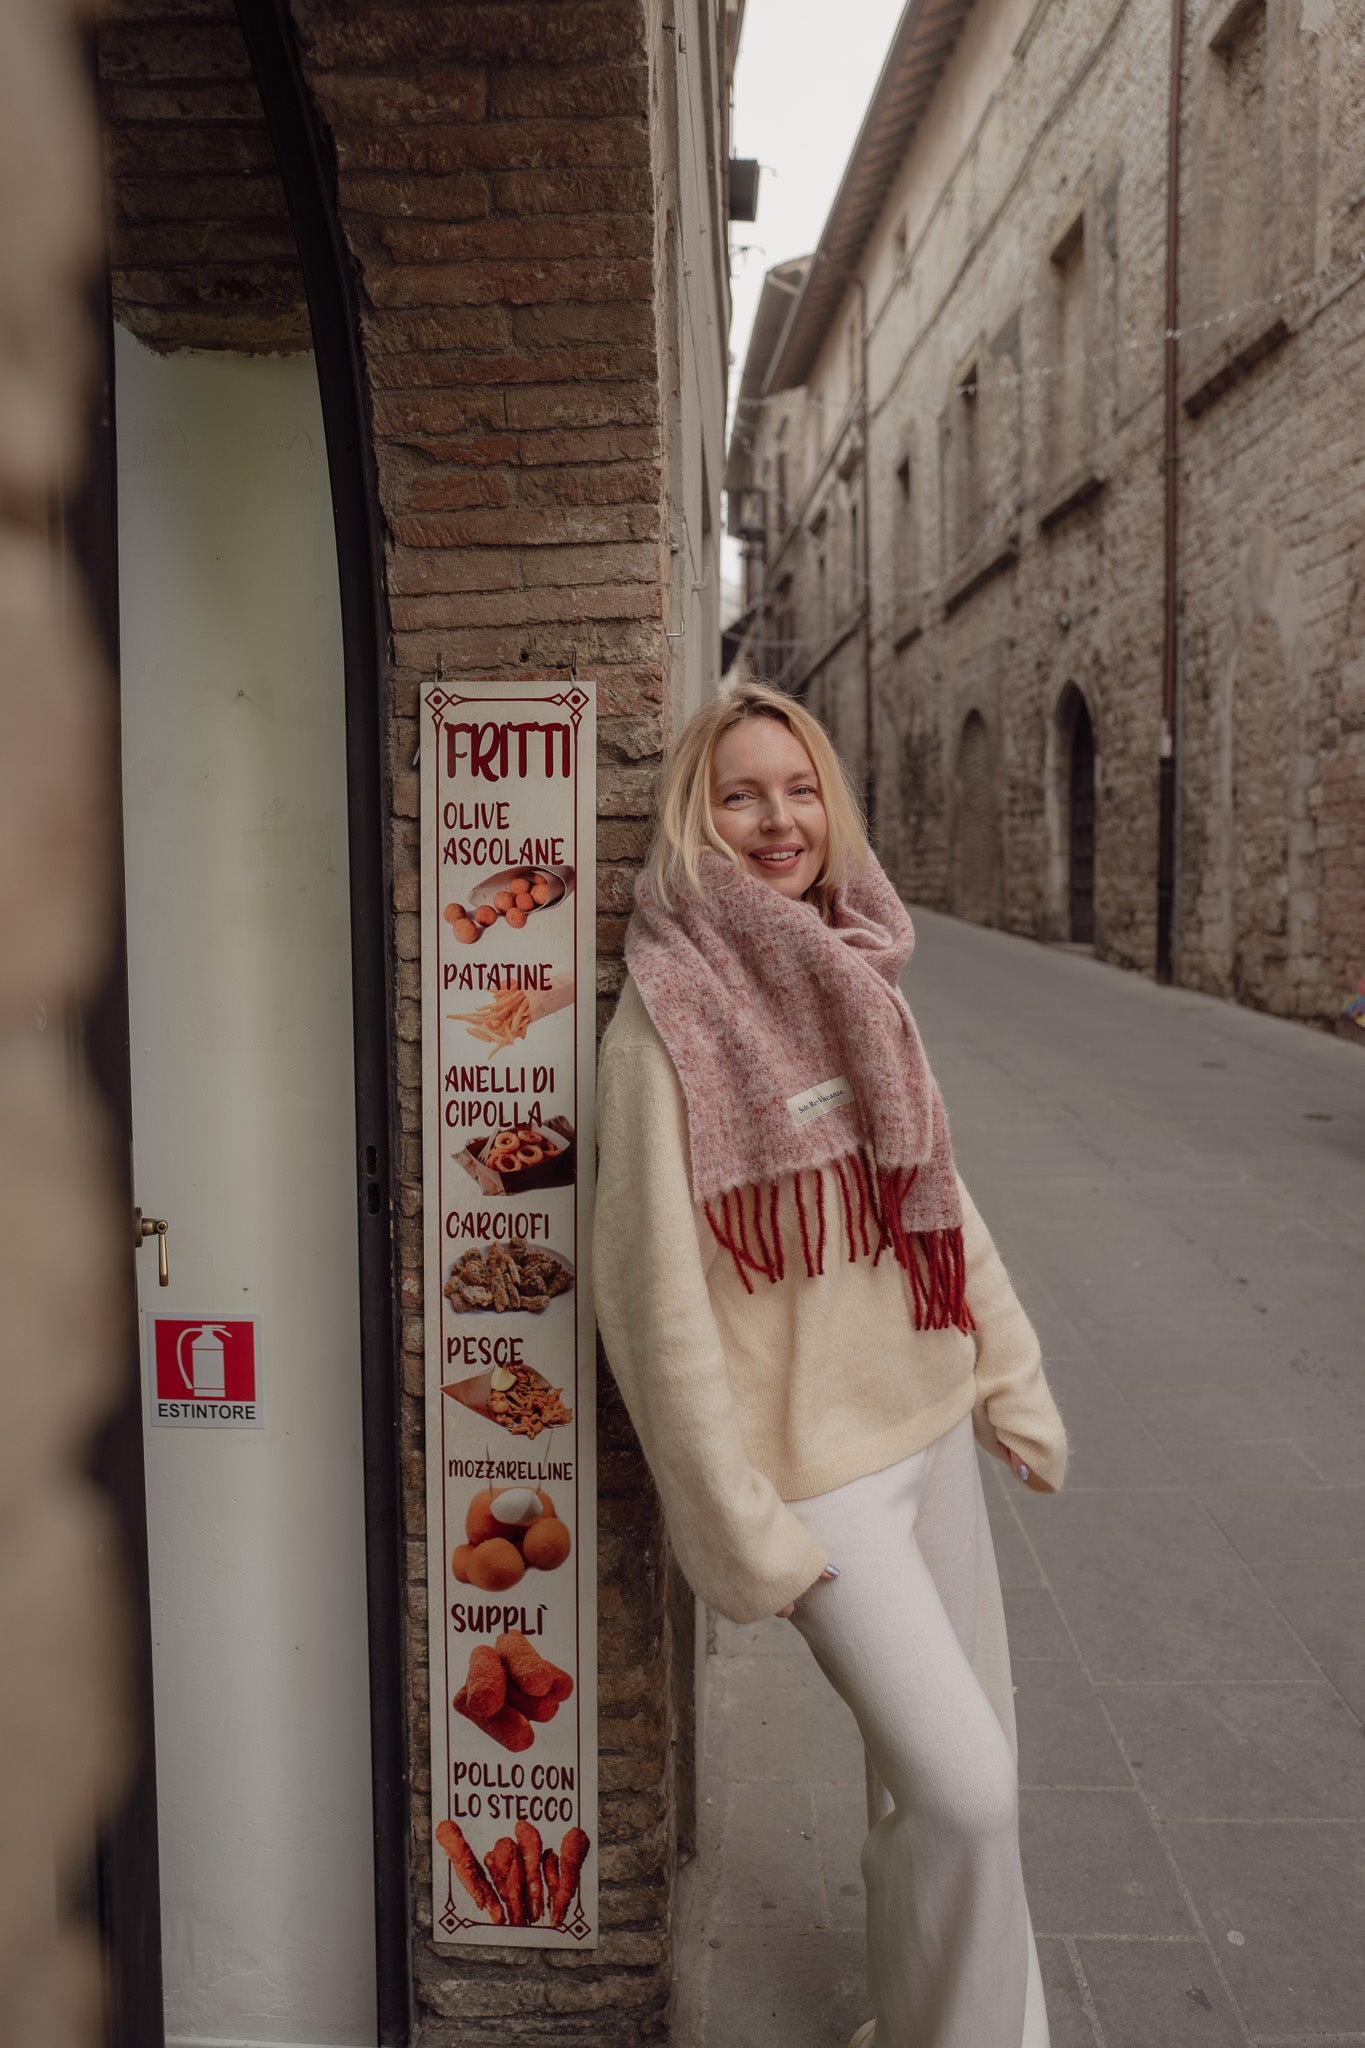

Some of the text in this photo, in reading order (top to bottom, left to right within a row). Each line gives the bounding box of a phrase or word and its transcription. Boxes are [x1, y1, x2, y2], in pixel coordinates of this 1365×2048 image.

[444, 721, 571, 782] FRITTI
[444, 802, 510, 830] OLIVE
[443, 837, 564, 866] ASCOLANE
[444, 964, 553, 992] PATATINE
[445, 1066, 555, 1094] ANELLI DI
[445, 1099, 543, 1129] CIPOLLA
[446, 1212, 549, 1240] CARCIOFI
[448, 1337, 523, 1365] PESCE
[158, 1403, 256, 1420] ESTINTORE
[448, 1459, 573, 1481] MOZZARELLINE
[452, 1603, 548, 1636] SUPPLÌ
[453, 1761, 574, 1791] POLLO CON
[454, 1793, 573, 1822] LO STECCO
